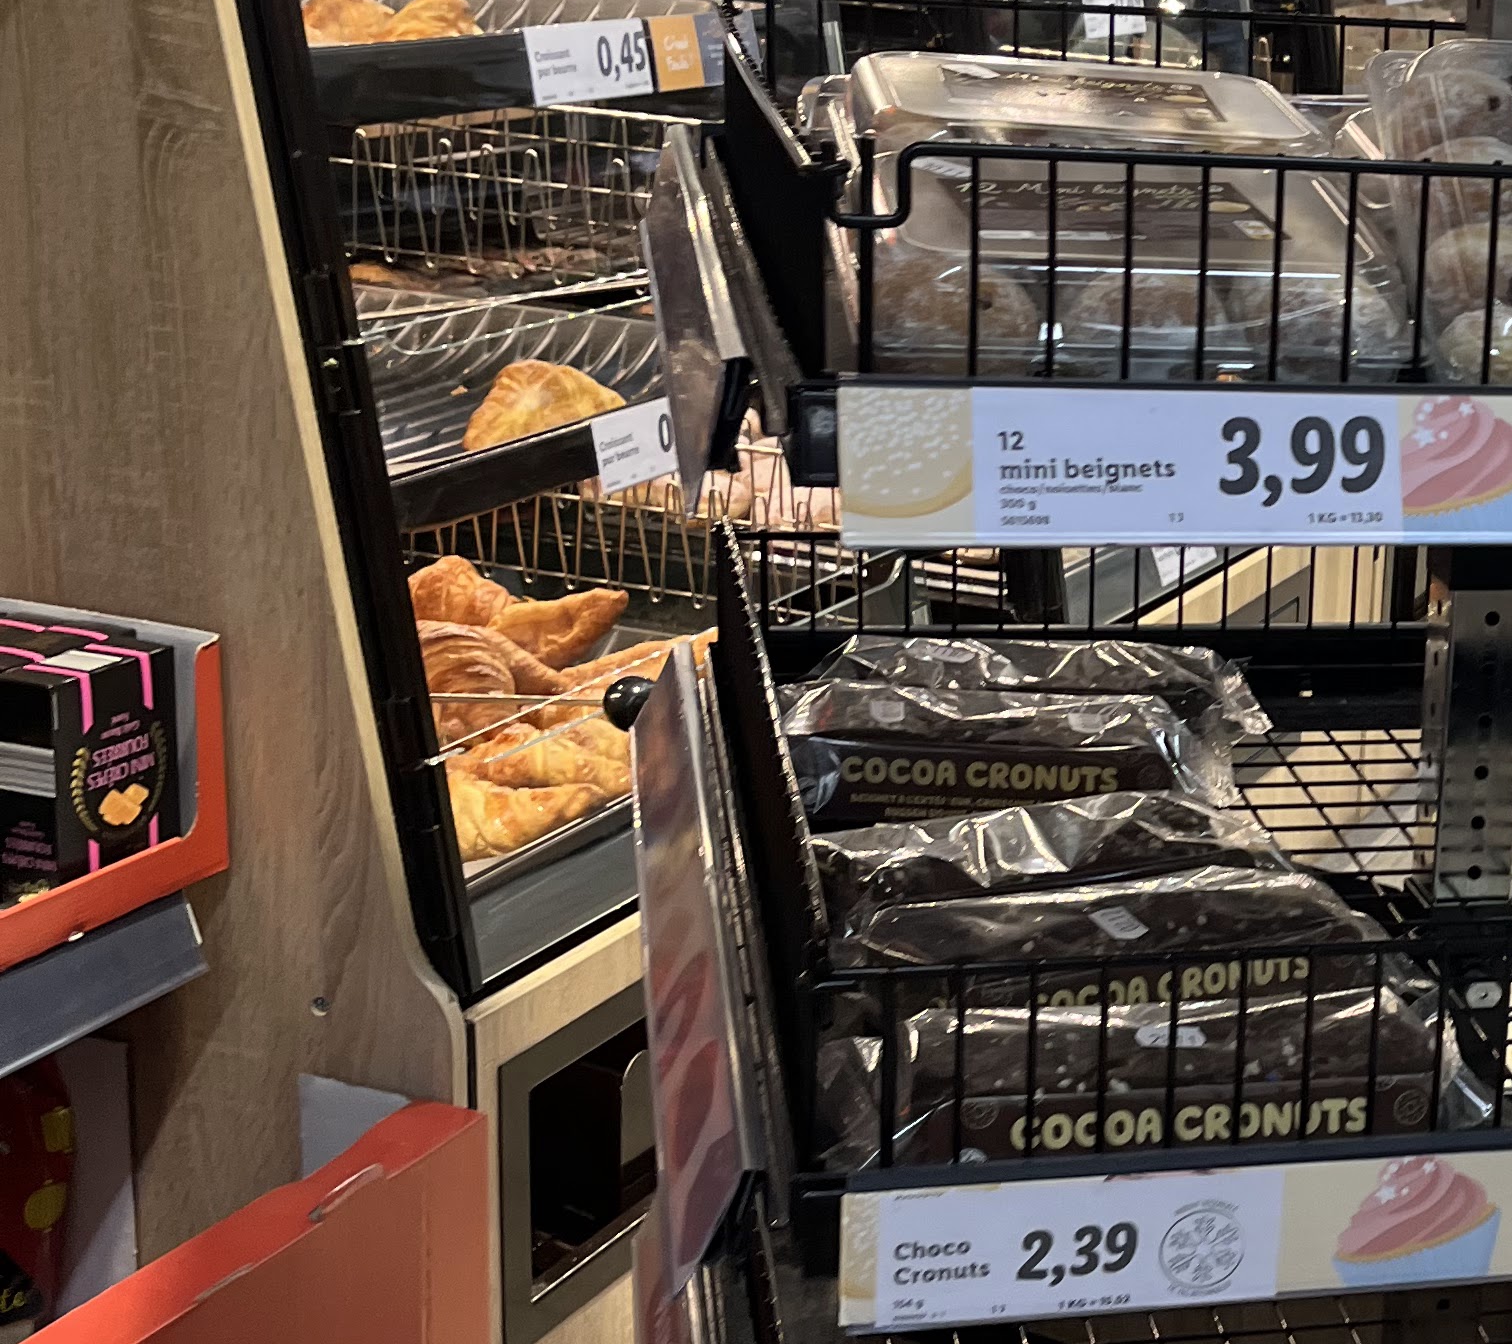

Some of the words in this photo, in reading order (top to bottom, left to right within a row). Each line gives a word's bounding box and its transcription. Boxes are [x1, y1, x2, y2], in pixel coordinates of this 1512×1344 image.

[597, 31, 646, 82] 0,45
[997, 431, 1025, 451] 12
[999, 458, 1057, 480] mini
[1064, 458, 1176, 483] beignets
[1218, 415, 1387, 507] 3,99
[841, 756, 958, 786] COCOA
[964, 760, 1119, 793] CRONUTS
[1036, 976, 1149, 1006] OCOA
[1010, 1107, 1165, 1151] COCOA
[1174, 1096, 1368, 1142] CRONUTS
[893, 1240, 971, 1262] Choco
[1016, 1222, 1138, 1287] 2,39
[893, 1261, 991, 1286] Cronuts
